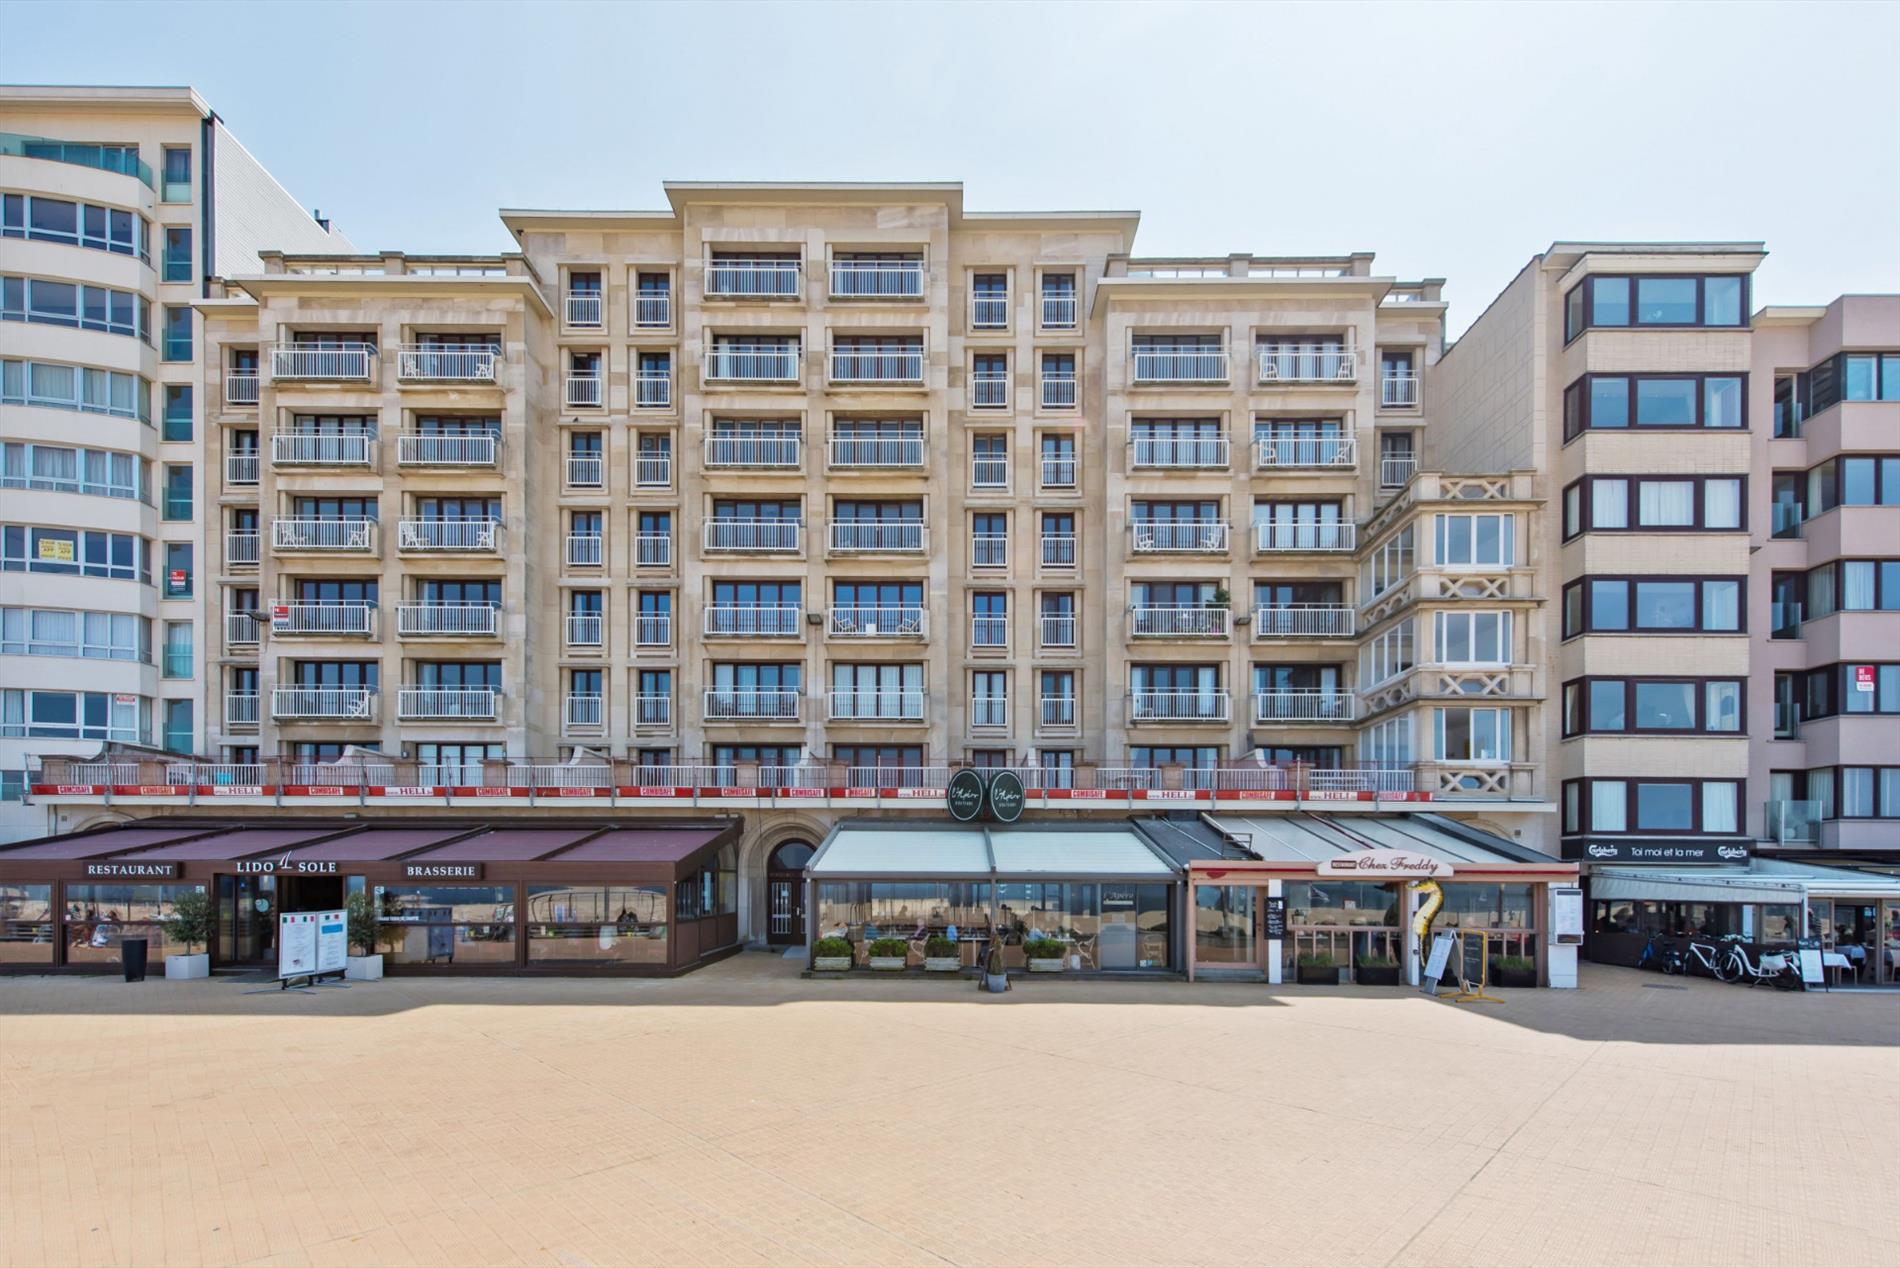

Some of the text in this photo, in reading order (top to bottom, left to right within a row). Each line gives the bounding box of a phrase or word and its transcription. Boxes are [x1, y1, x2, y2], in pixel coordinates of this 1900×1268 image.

[1588, 844, 1618, 857] Carlsberg
[1631, 847, 1704, 857] Toi moi et la mer
[1717, 846, 1747, 859] Carlsberg
[88, 865, 173, 875] RESTAURANT
[236, 862, 336, 873] LIDO SOLE
[407, 866, 476, 876] BRASSERIE
[1391, 856, 1439, 875] Freddy
